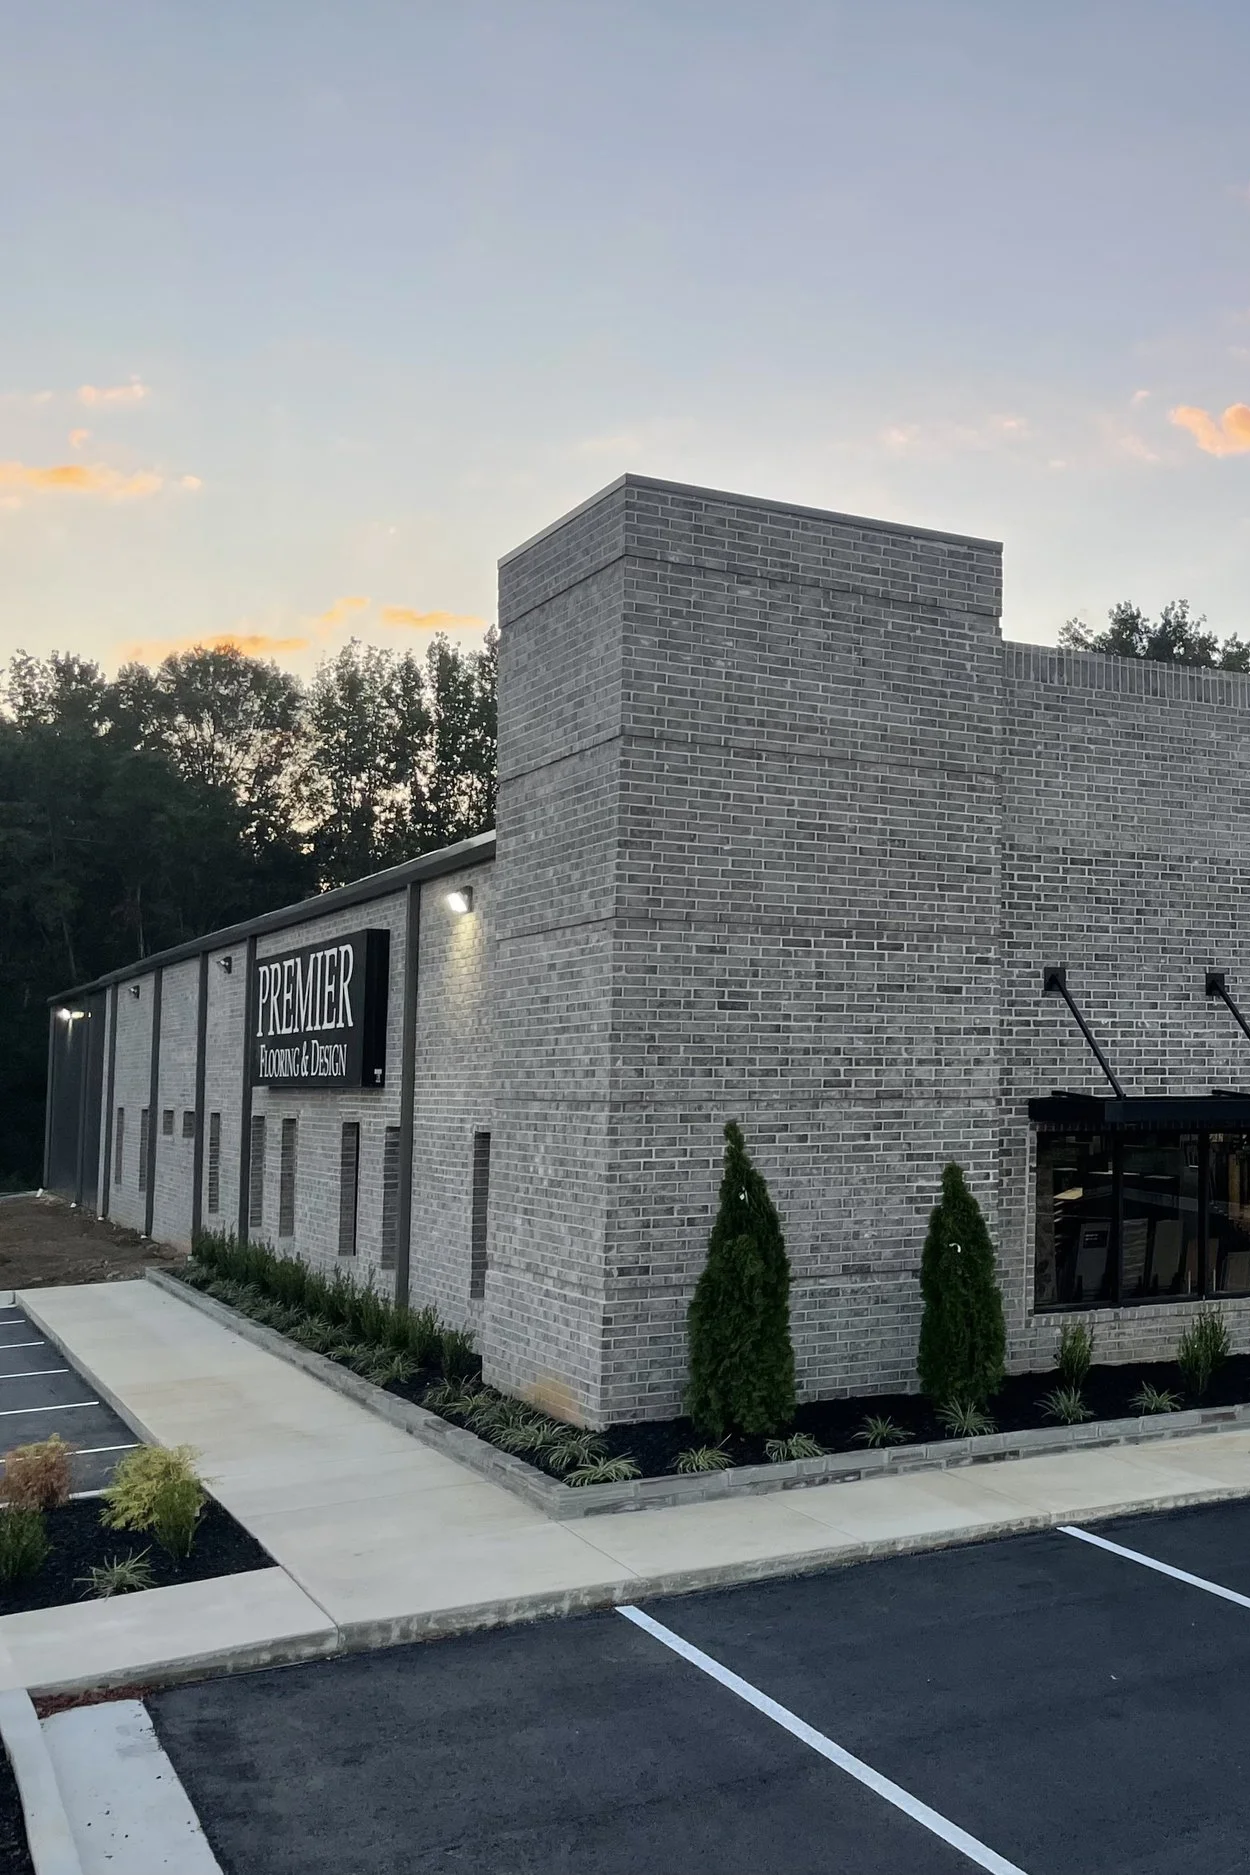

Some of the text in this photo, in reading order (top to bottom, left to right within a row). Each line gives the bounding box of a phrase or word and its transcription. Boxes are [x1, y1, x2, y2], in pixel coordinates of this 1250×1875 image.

[256, 944, 354, 1037] PREMIER
[259, 1044, 300, 1077] FLOORING
[301, 1041, 309, 1077] &
[311, 1040, 347, 1077] DESIGN
